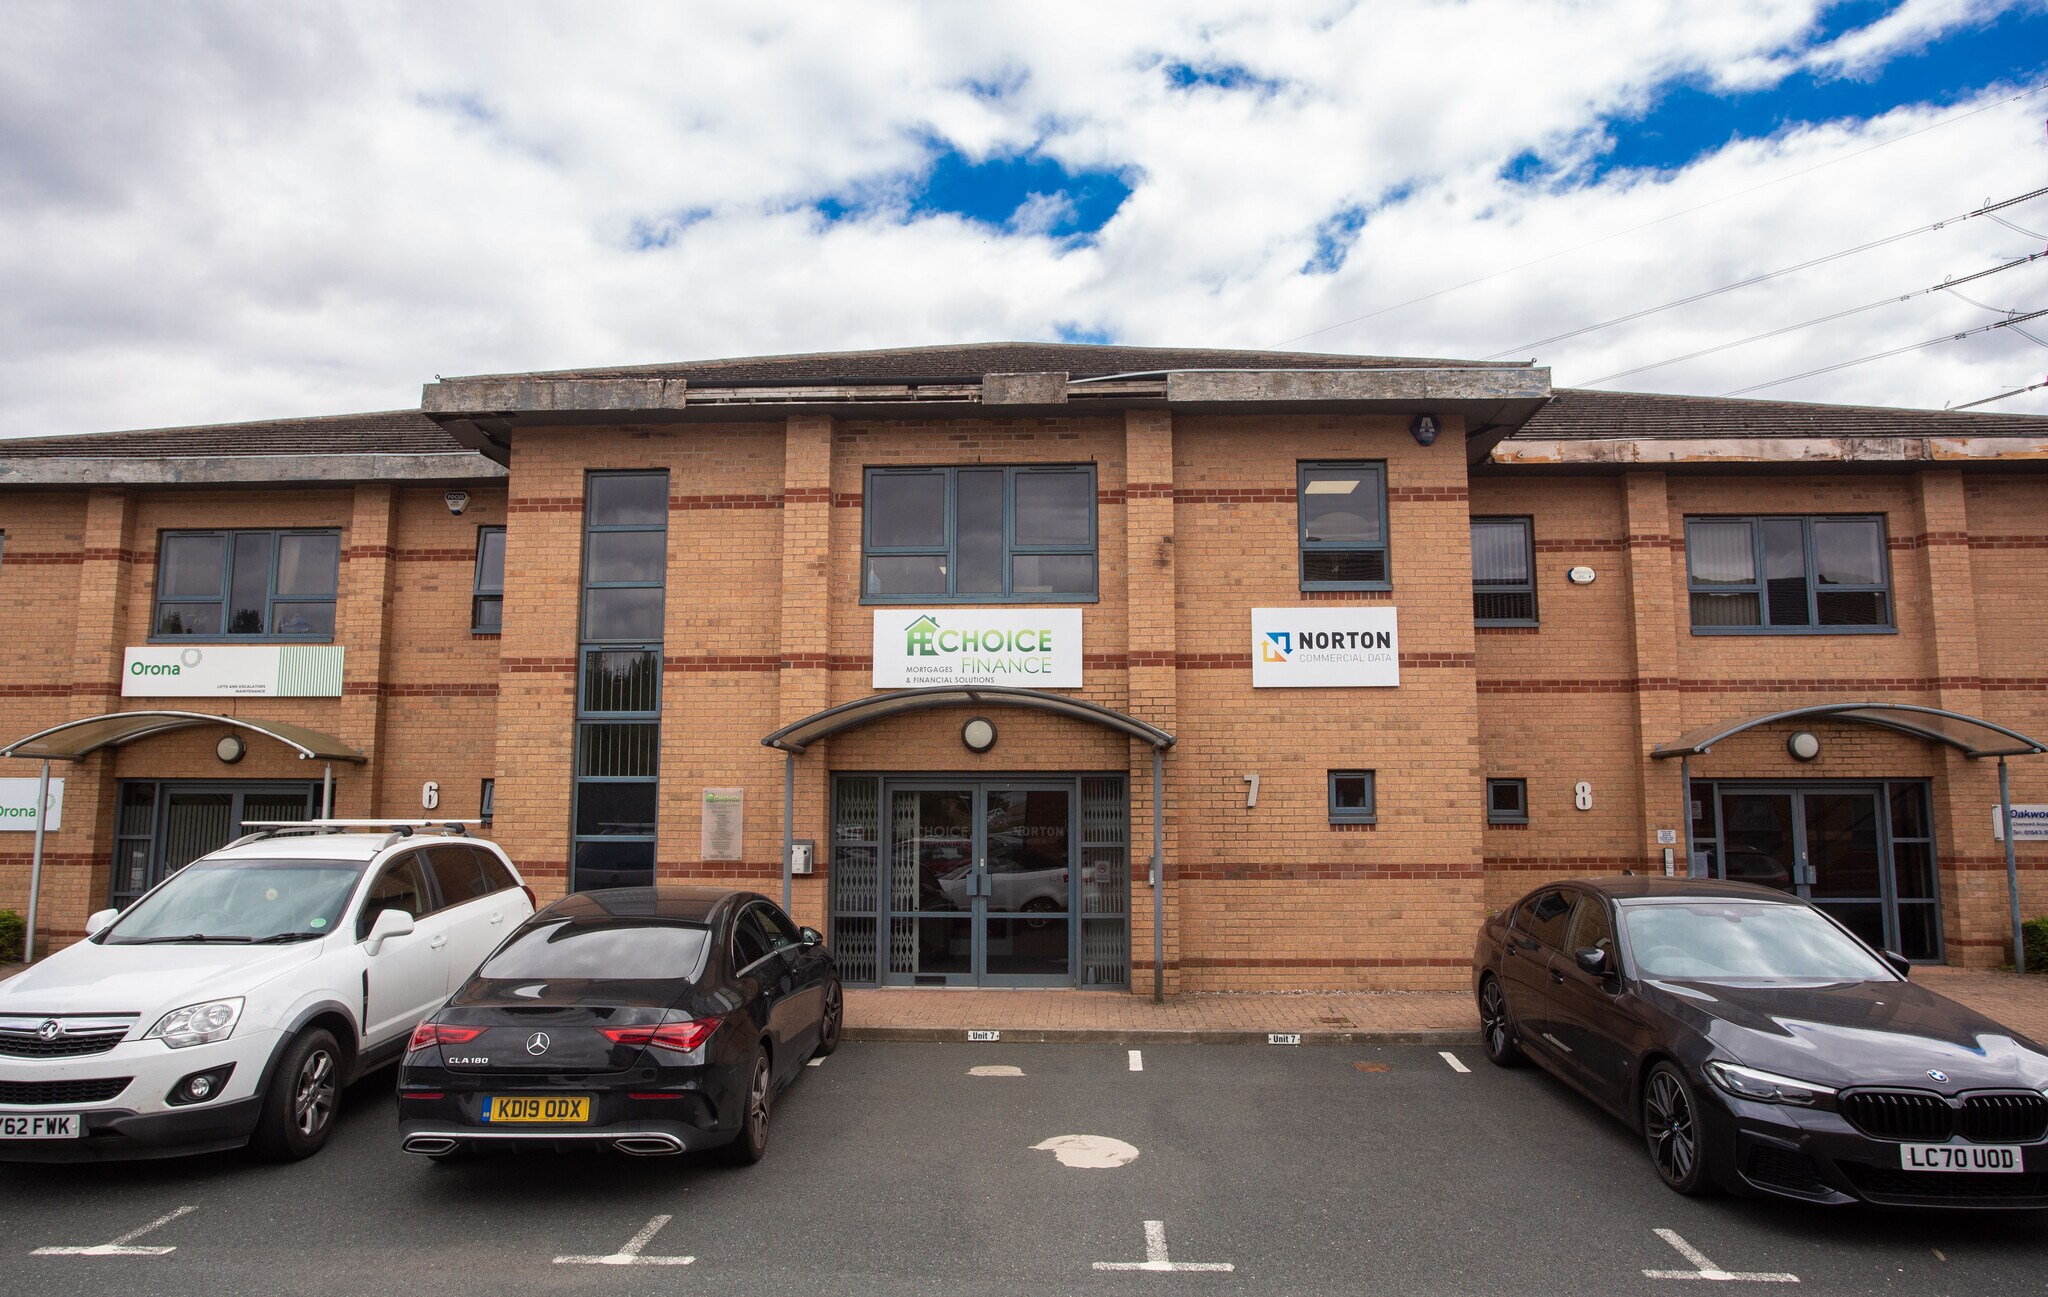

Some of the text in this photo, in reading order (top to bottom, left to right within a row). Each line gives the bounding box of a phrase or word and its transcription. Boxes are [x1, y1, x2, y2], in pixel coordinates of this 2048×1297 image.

[938, 629, 1052, 652] CHOICE
[1299, 631, 1391, 649] NORTON
[961, 657, 1052, 674] FINANCE
[1300, 653, 1392, 663] COMMERCIAL DATA
[131, 662, 181, 676] Orona
[422, 781, 439, 809] 6
[1243, 775, 1260, 807] 7
[1575, 781, 1593, 810] 8
[1273, 1035, 1296, 1043] Unit 7
[498, 1100, 582, 1118] KD19 ODX
[33, 1118, 70, 1134] FWK
[1910, 1147, 2014, 1168] LC70 UOD
